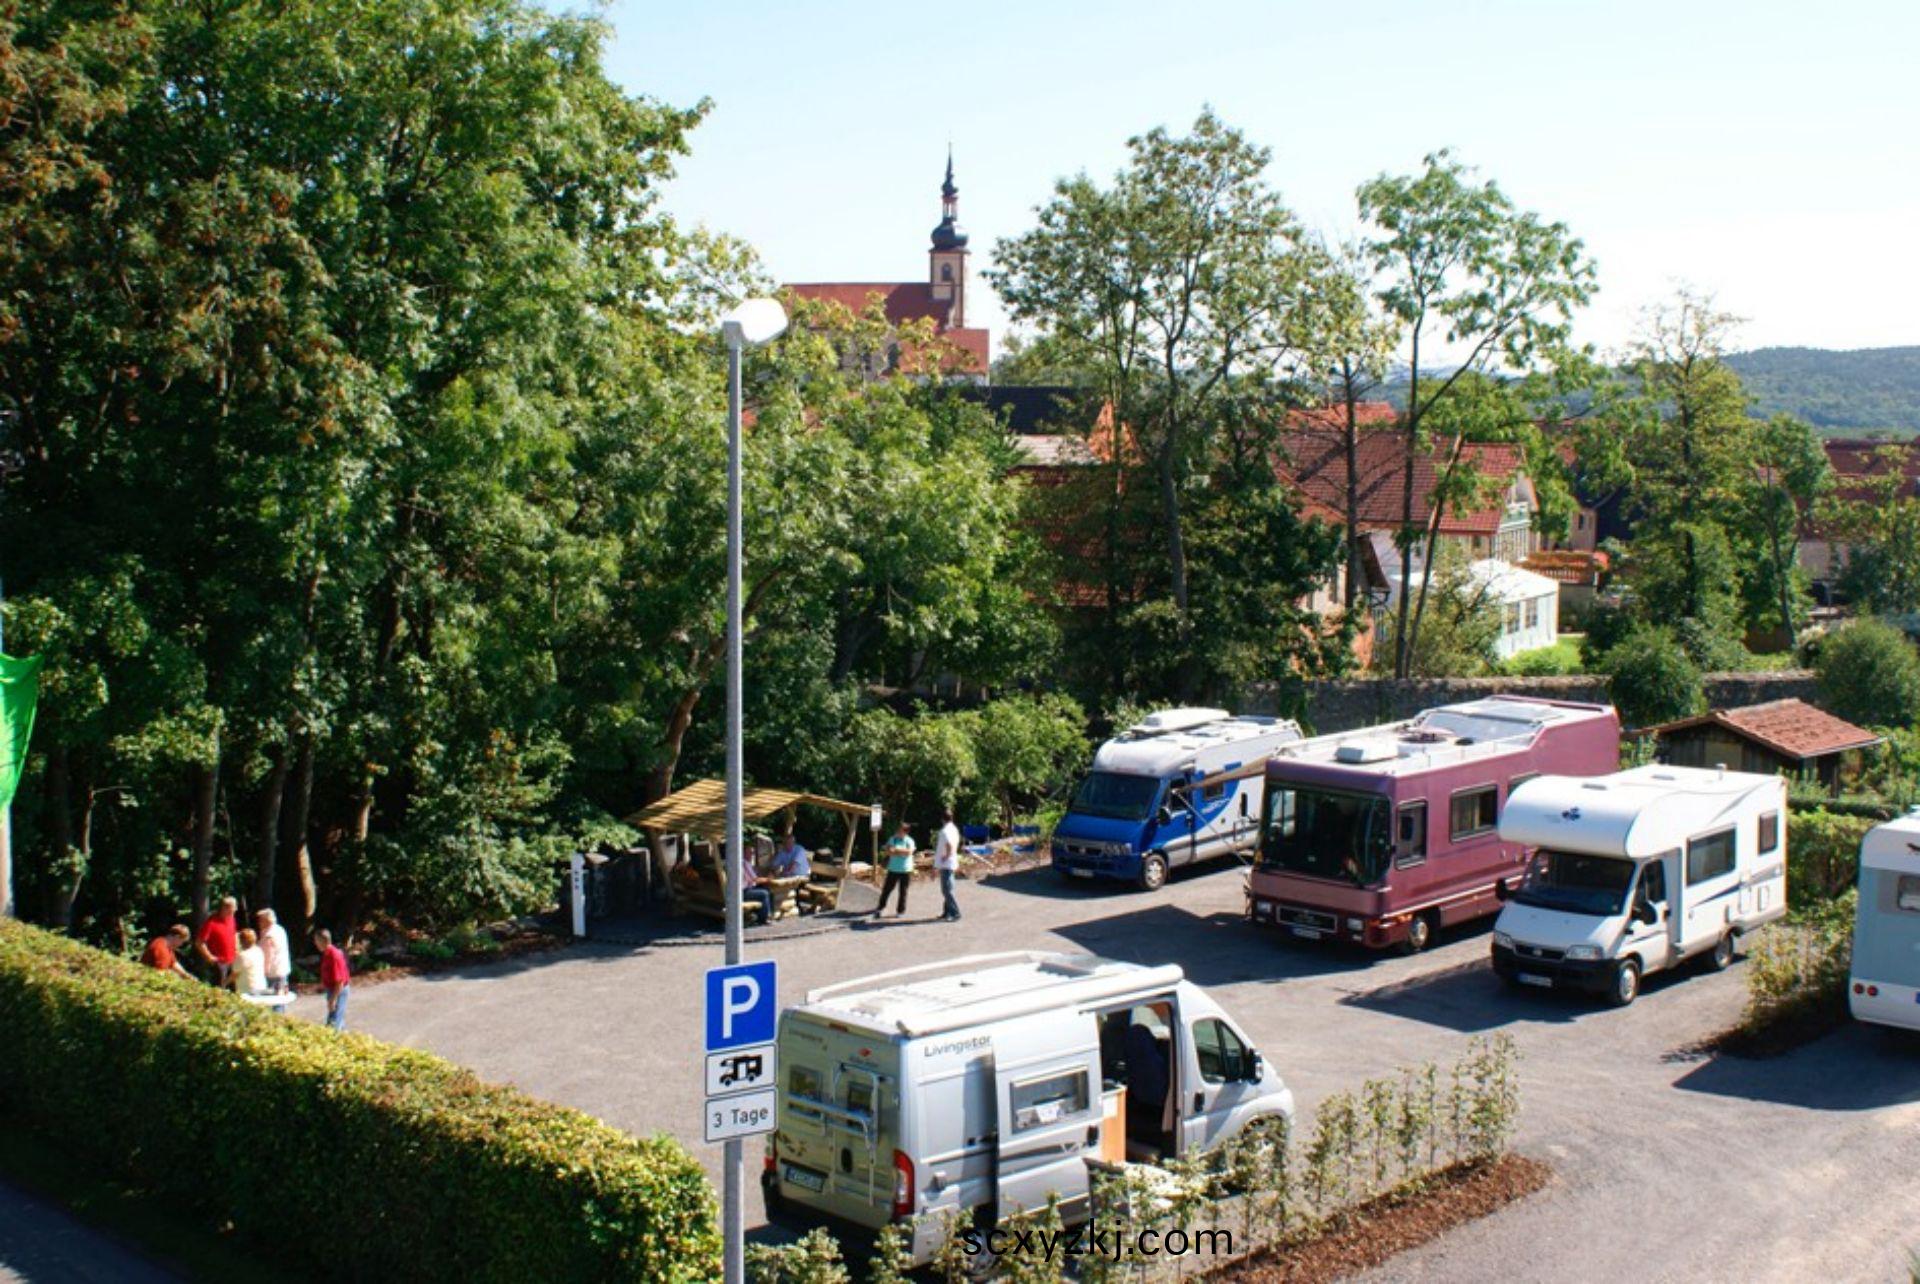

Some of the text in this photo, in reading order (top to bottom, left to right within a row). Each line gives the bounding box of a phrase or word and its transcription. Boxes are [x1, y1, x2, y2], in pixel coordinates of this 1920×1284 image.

[722, 975, 761, 1040] P
[713, 1107, 769, 1128] 3 Tage
